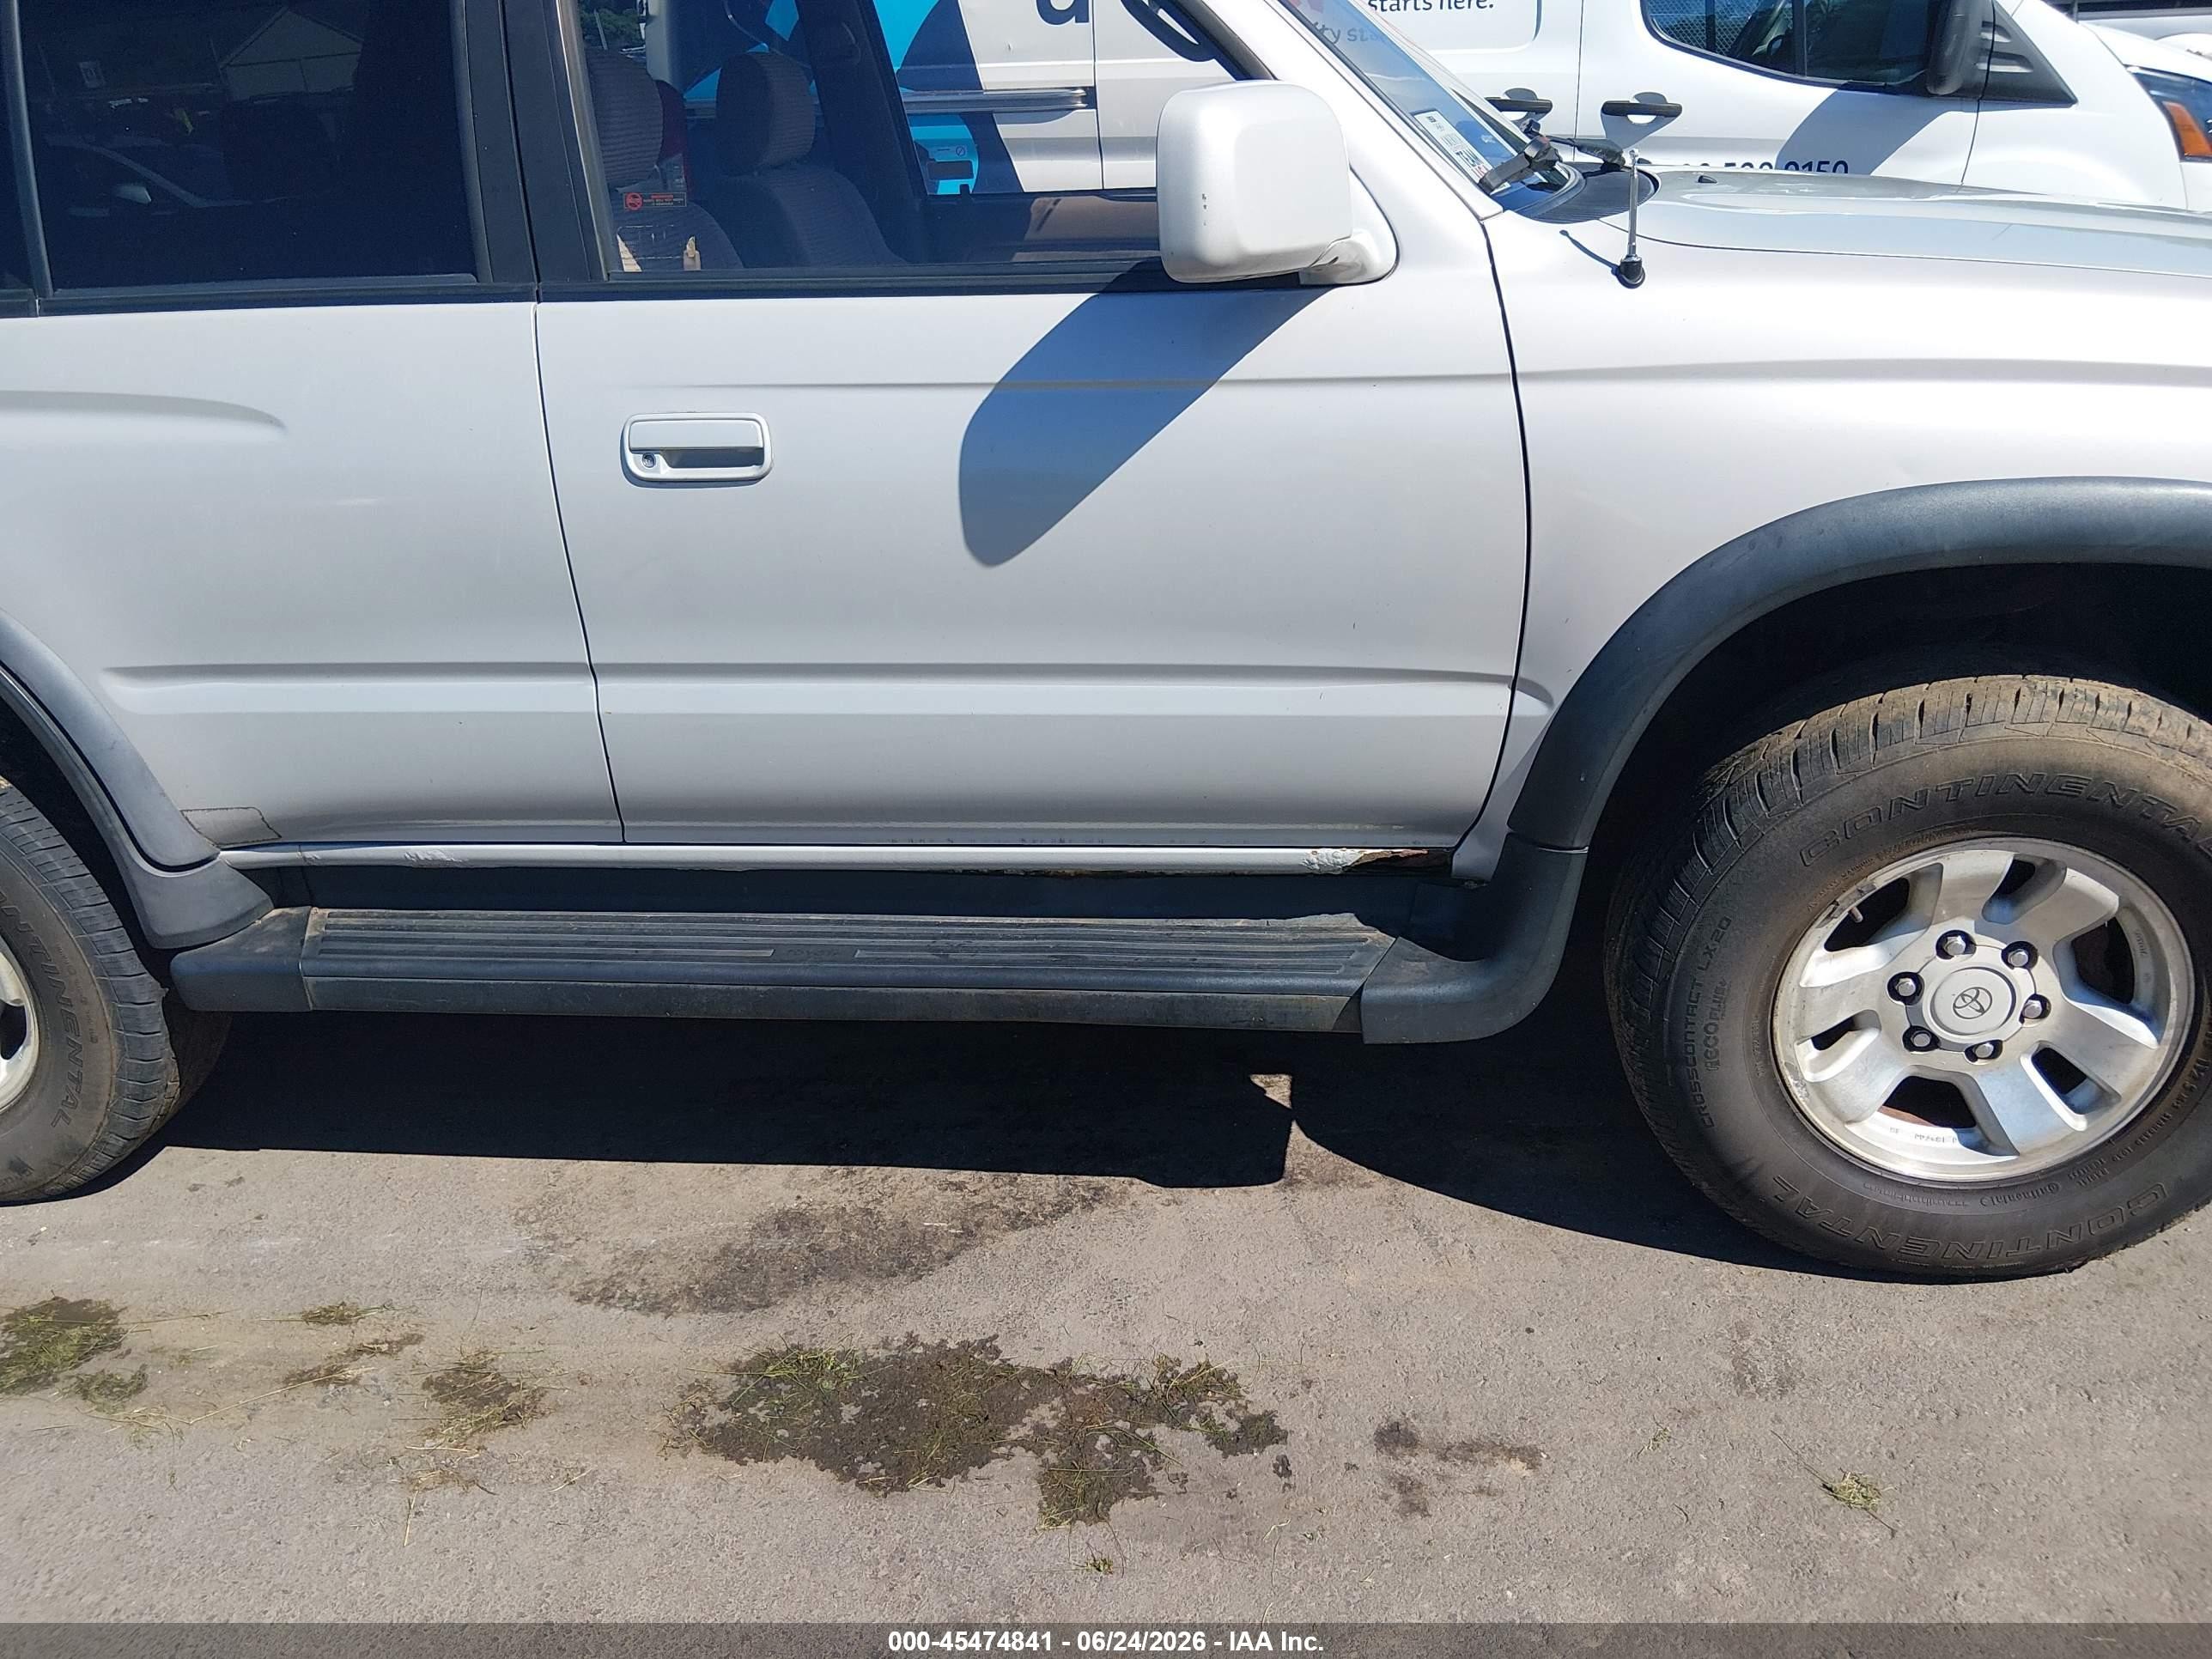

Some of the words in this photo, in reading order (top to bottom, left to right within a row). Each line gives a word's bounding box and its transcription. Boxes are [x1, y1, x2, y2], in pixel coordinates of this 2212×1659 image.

[1368, 0, 1433, 12] starts
[1684, 978, 1715, 1128] CROSSCONTACT
[1773, 1174, 2169, 1260] CONTINENTAL
